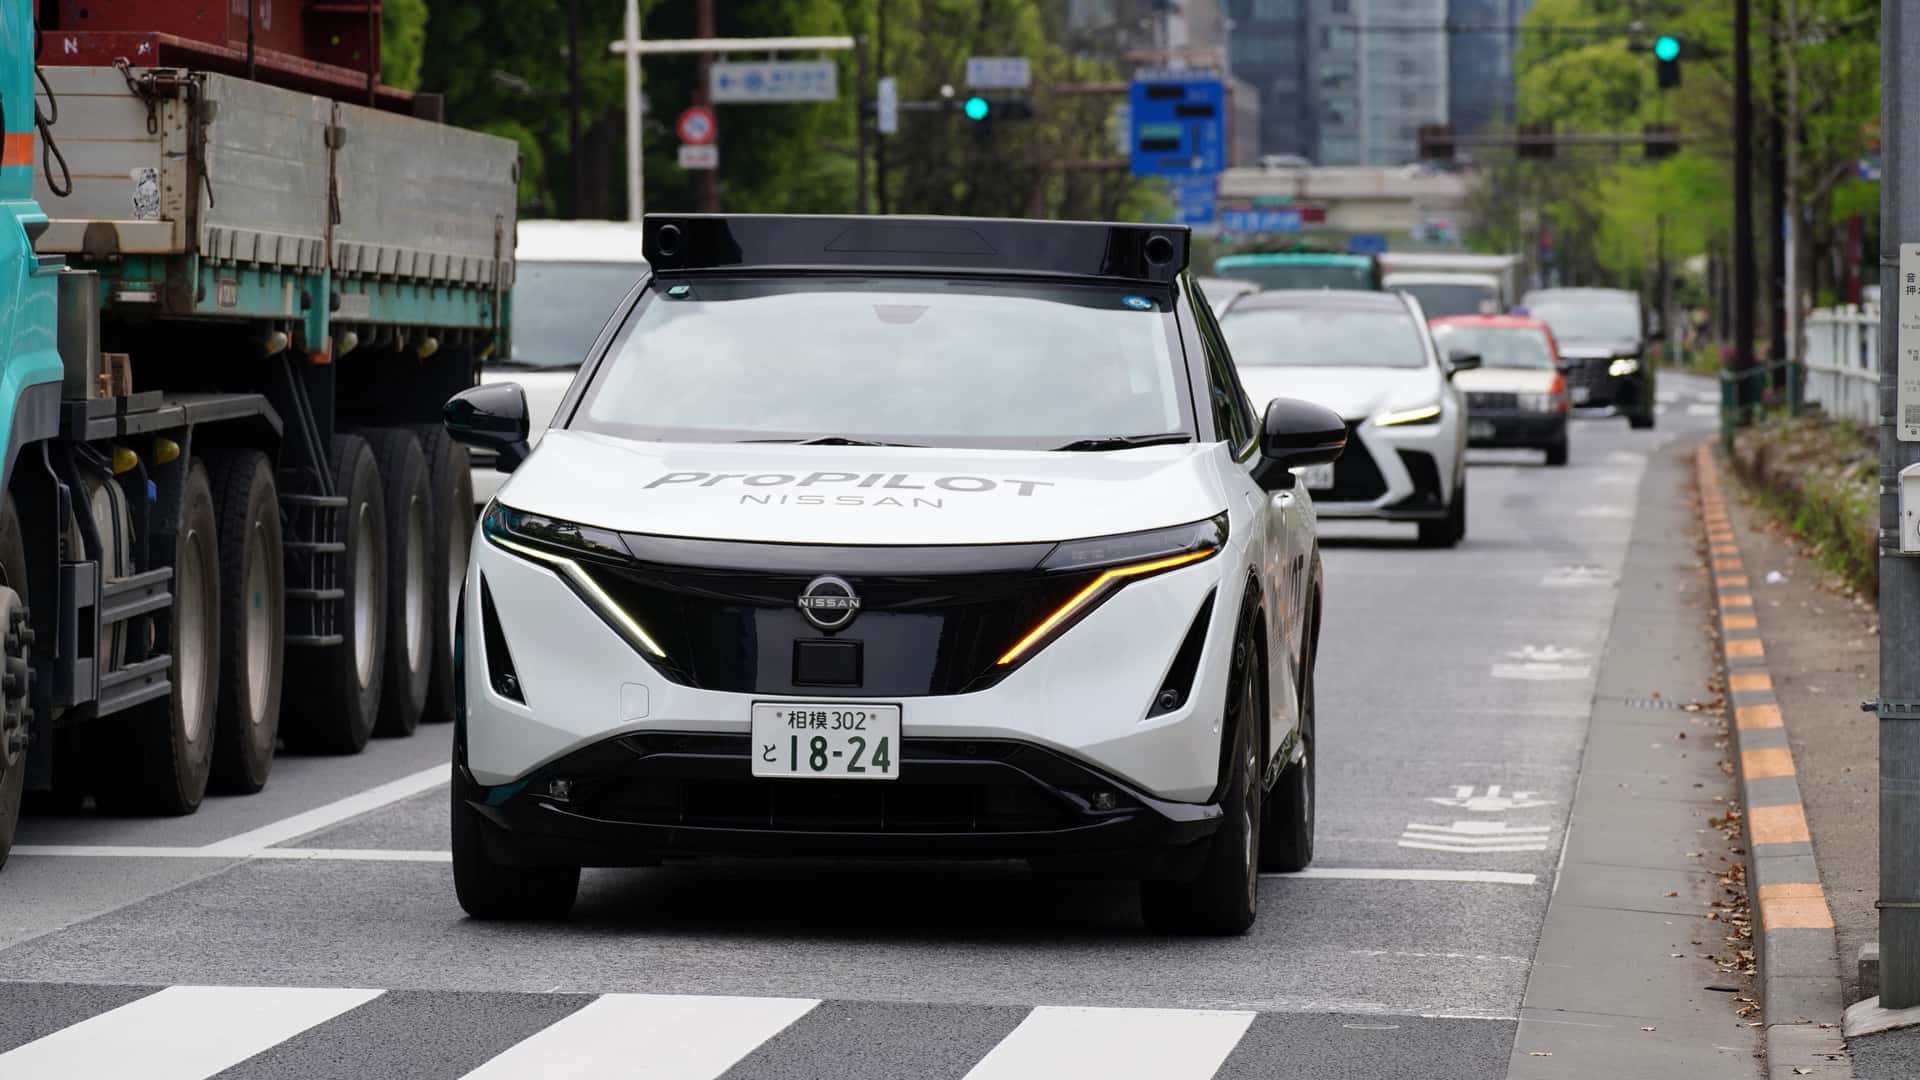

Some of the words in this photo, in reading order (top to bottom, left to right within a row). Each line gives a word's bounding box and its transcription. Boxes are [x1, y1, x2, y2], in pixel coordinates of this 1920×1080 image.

[1906, 285, 1920, 296] 押
[739, 494, 943, 509] NISSAN
[798, 598, 861, 608] NISSAN
[790, 734, 891, 774] 18-24
